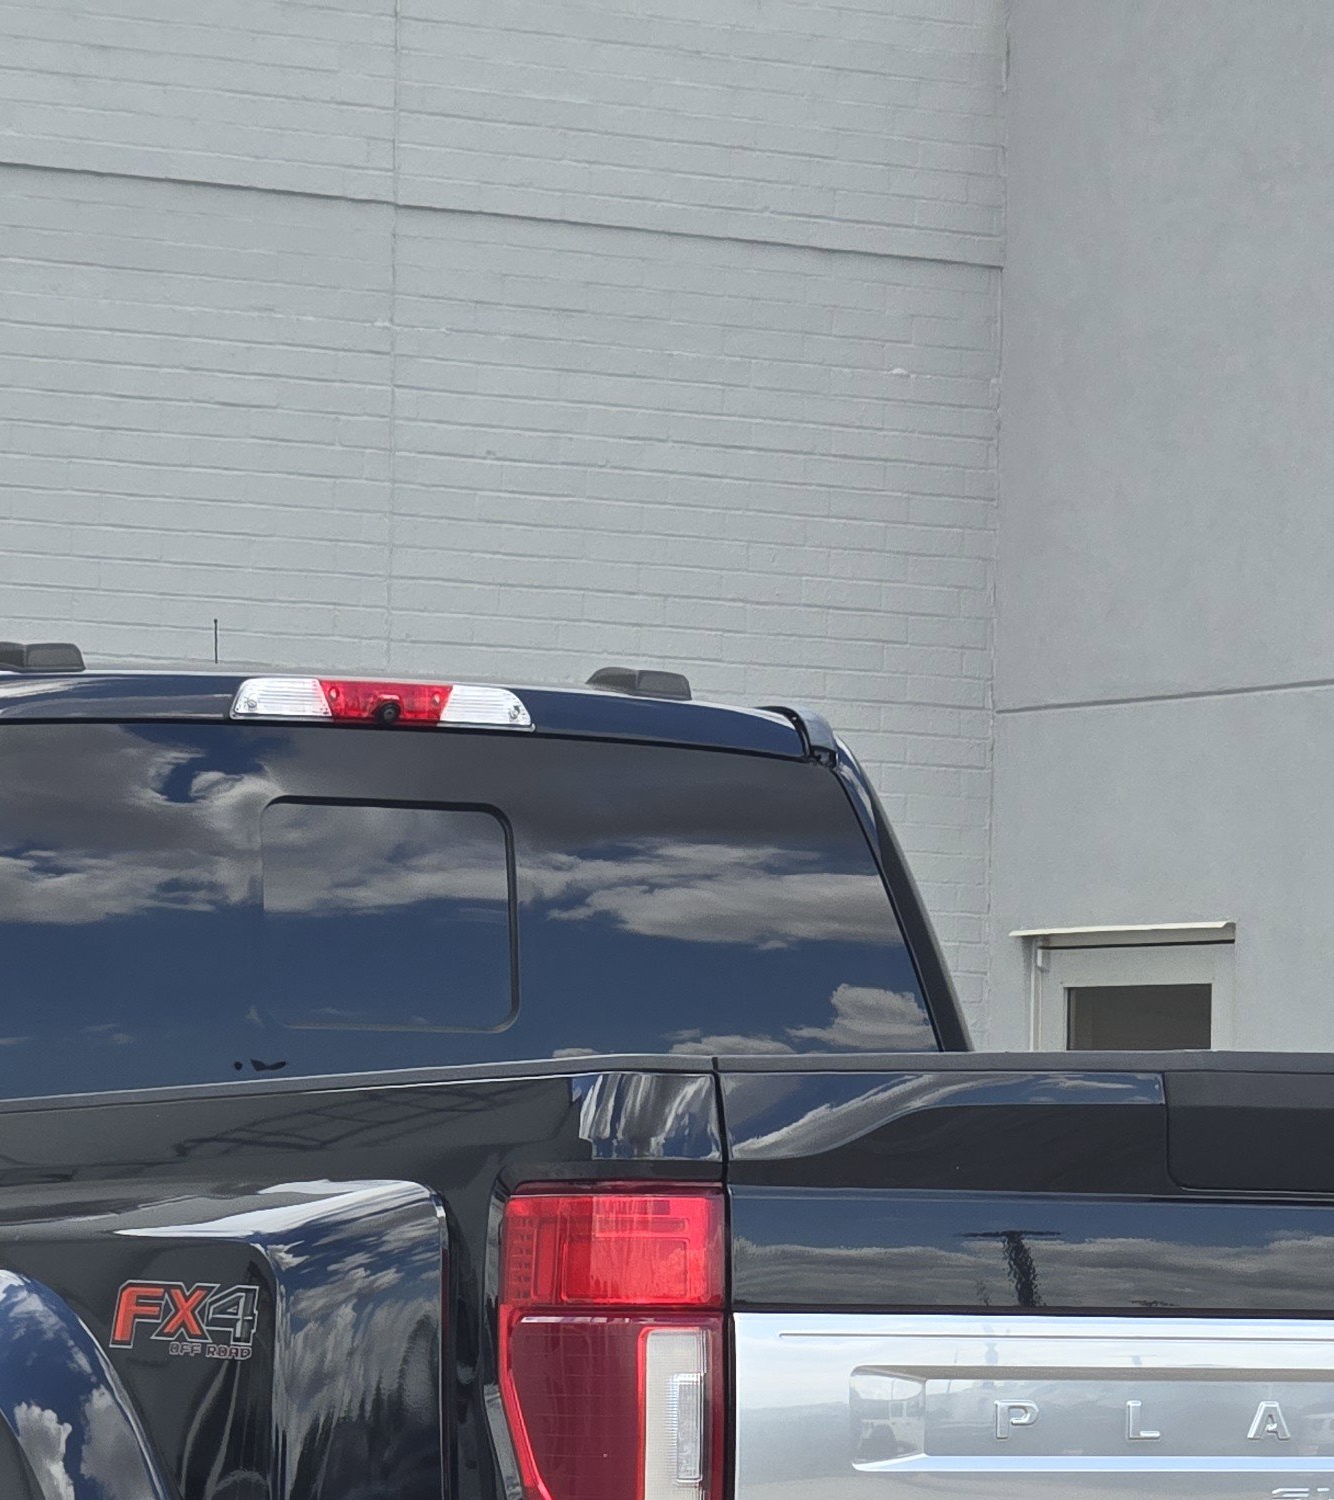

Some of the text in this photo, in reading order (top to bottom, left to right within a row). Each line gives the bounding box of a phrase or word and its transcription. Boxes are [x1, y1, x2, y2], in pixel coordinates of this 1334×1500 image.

[109, 1279, 260, 1349] FX4
[169, 1342, 253, 1361] OFF ROAD
